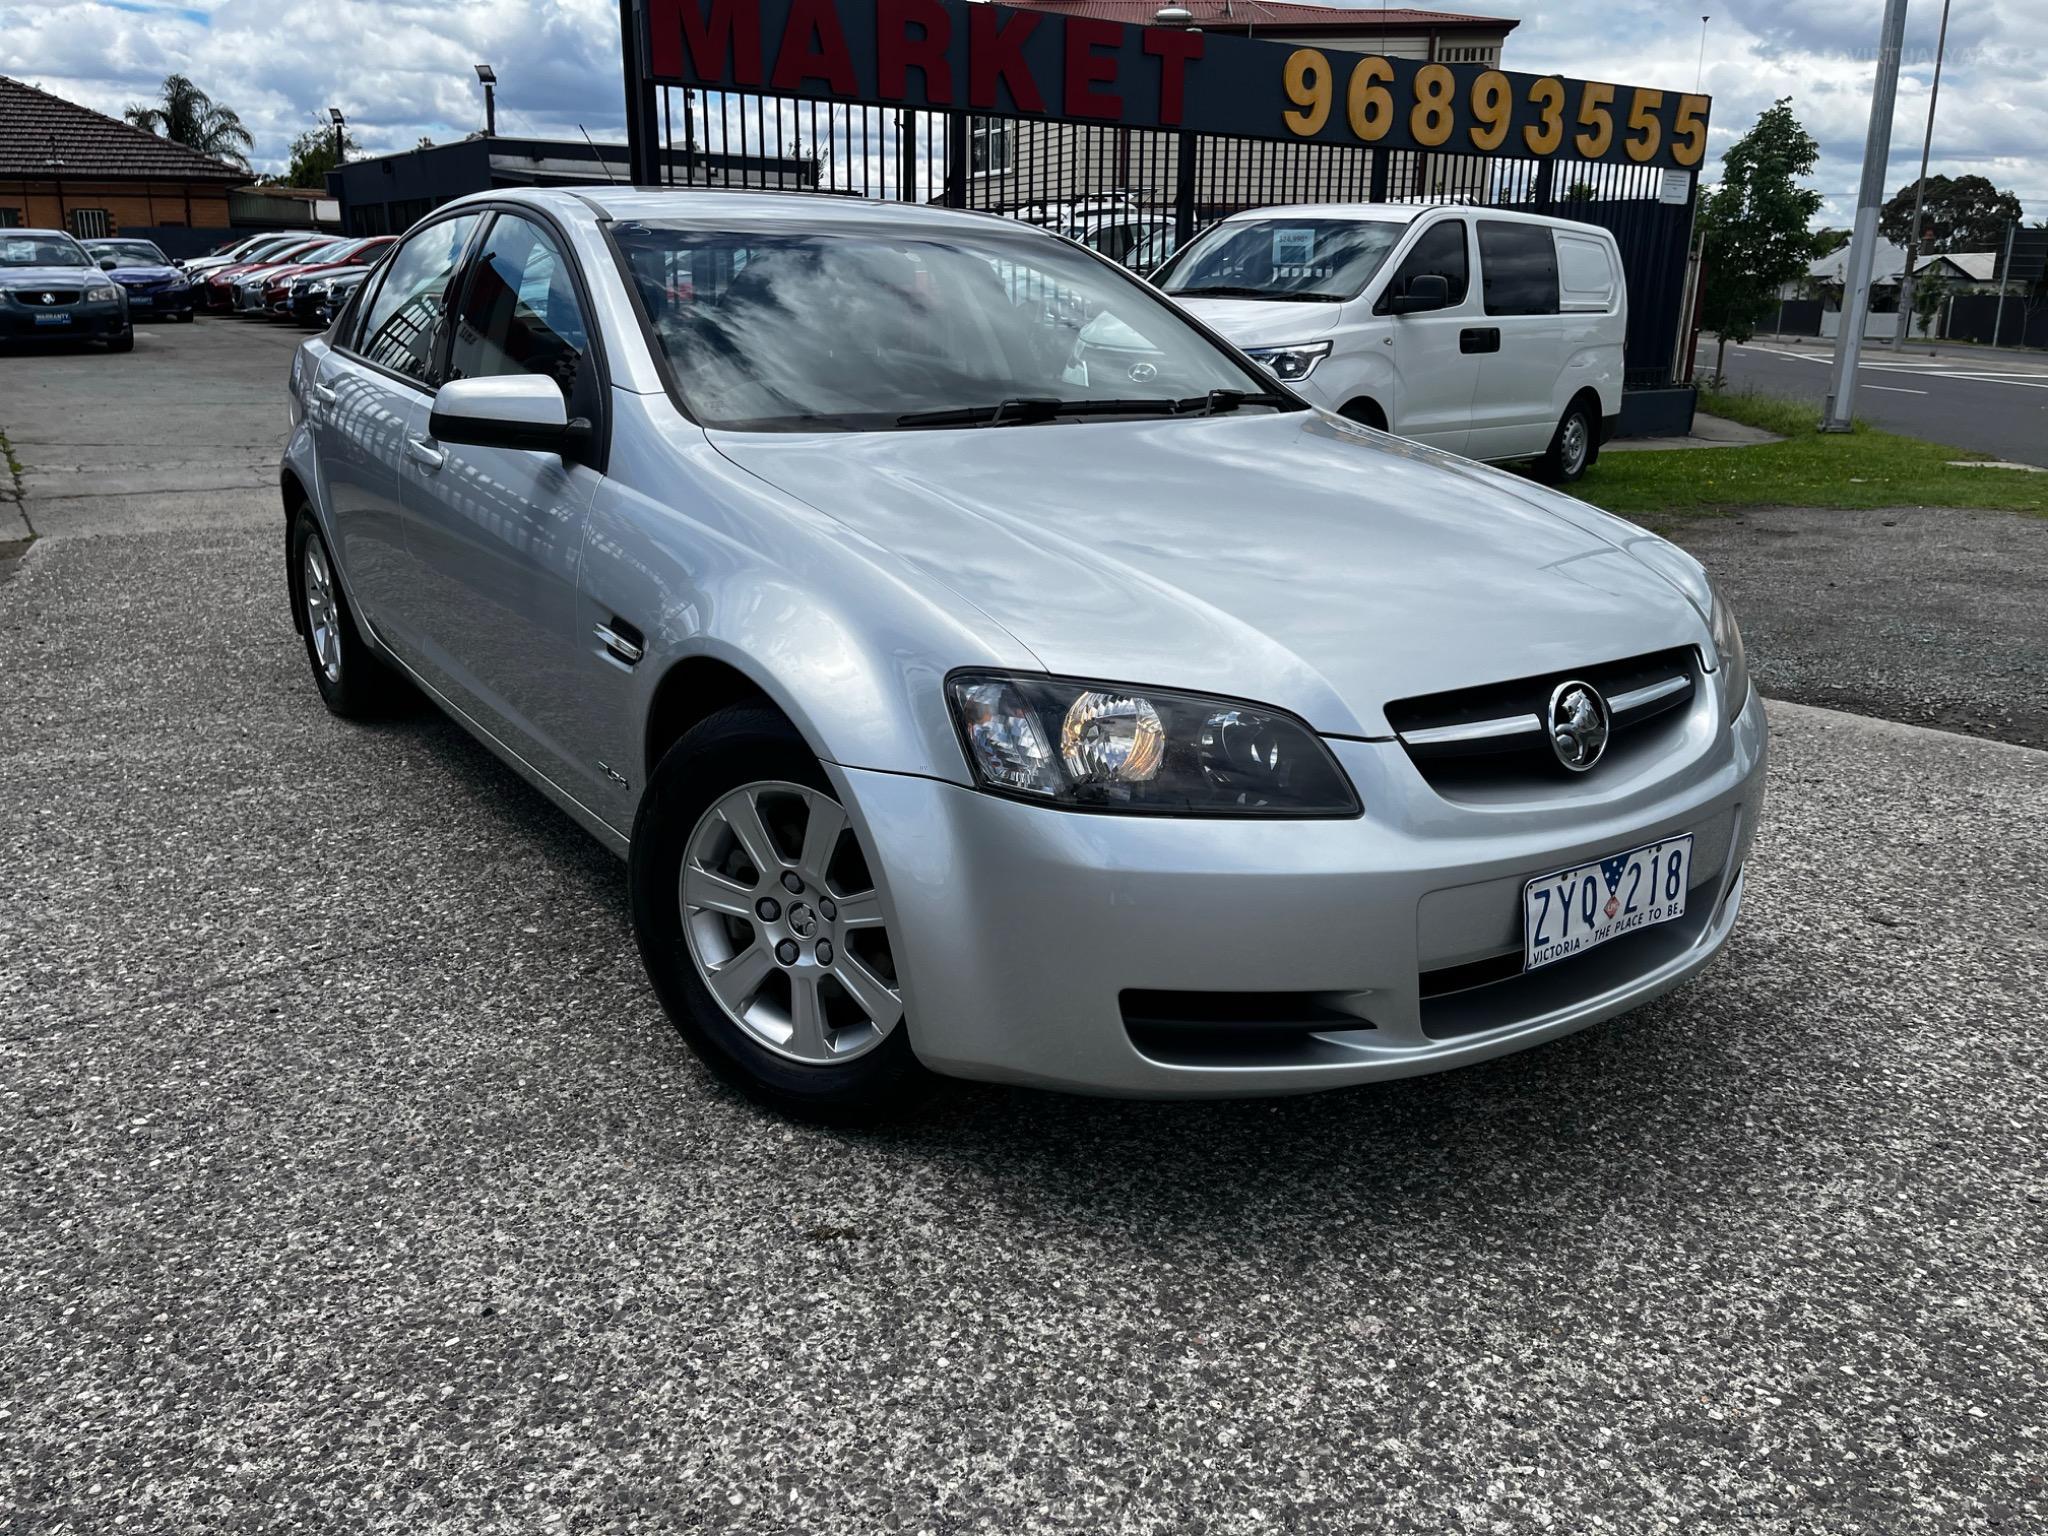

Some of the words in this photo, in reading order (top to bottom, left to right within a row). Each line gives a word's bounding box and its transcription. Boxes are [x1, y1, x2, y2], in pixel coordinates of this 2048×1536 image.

[648, 0, 1204, 125] MARKET
[1282, 48, 1707, 167] 96893555
[1533, 875, 1598, 948] ZYQ
[1623, 849, 1682, 915] 218
[1533, 937, 1581, 965] VICTORIA
[1594, 926, 1611, 943] THE
[1614, 912, 1644, 936] PLACE
[1648, 907, 1662, 921] TO
